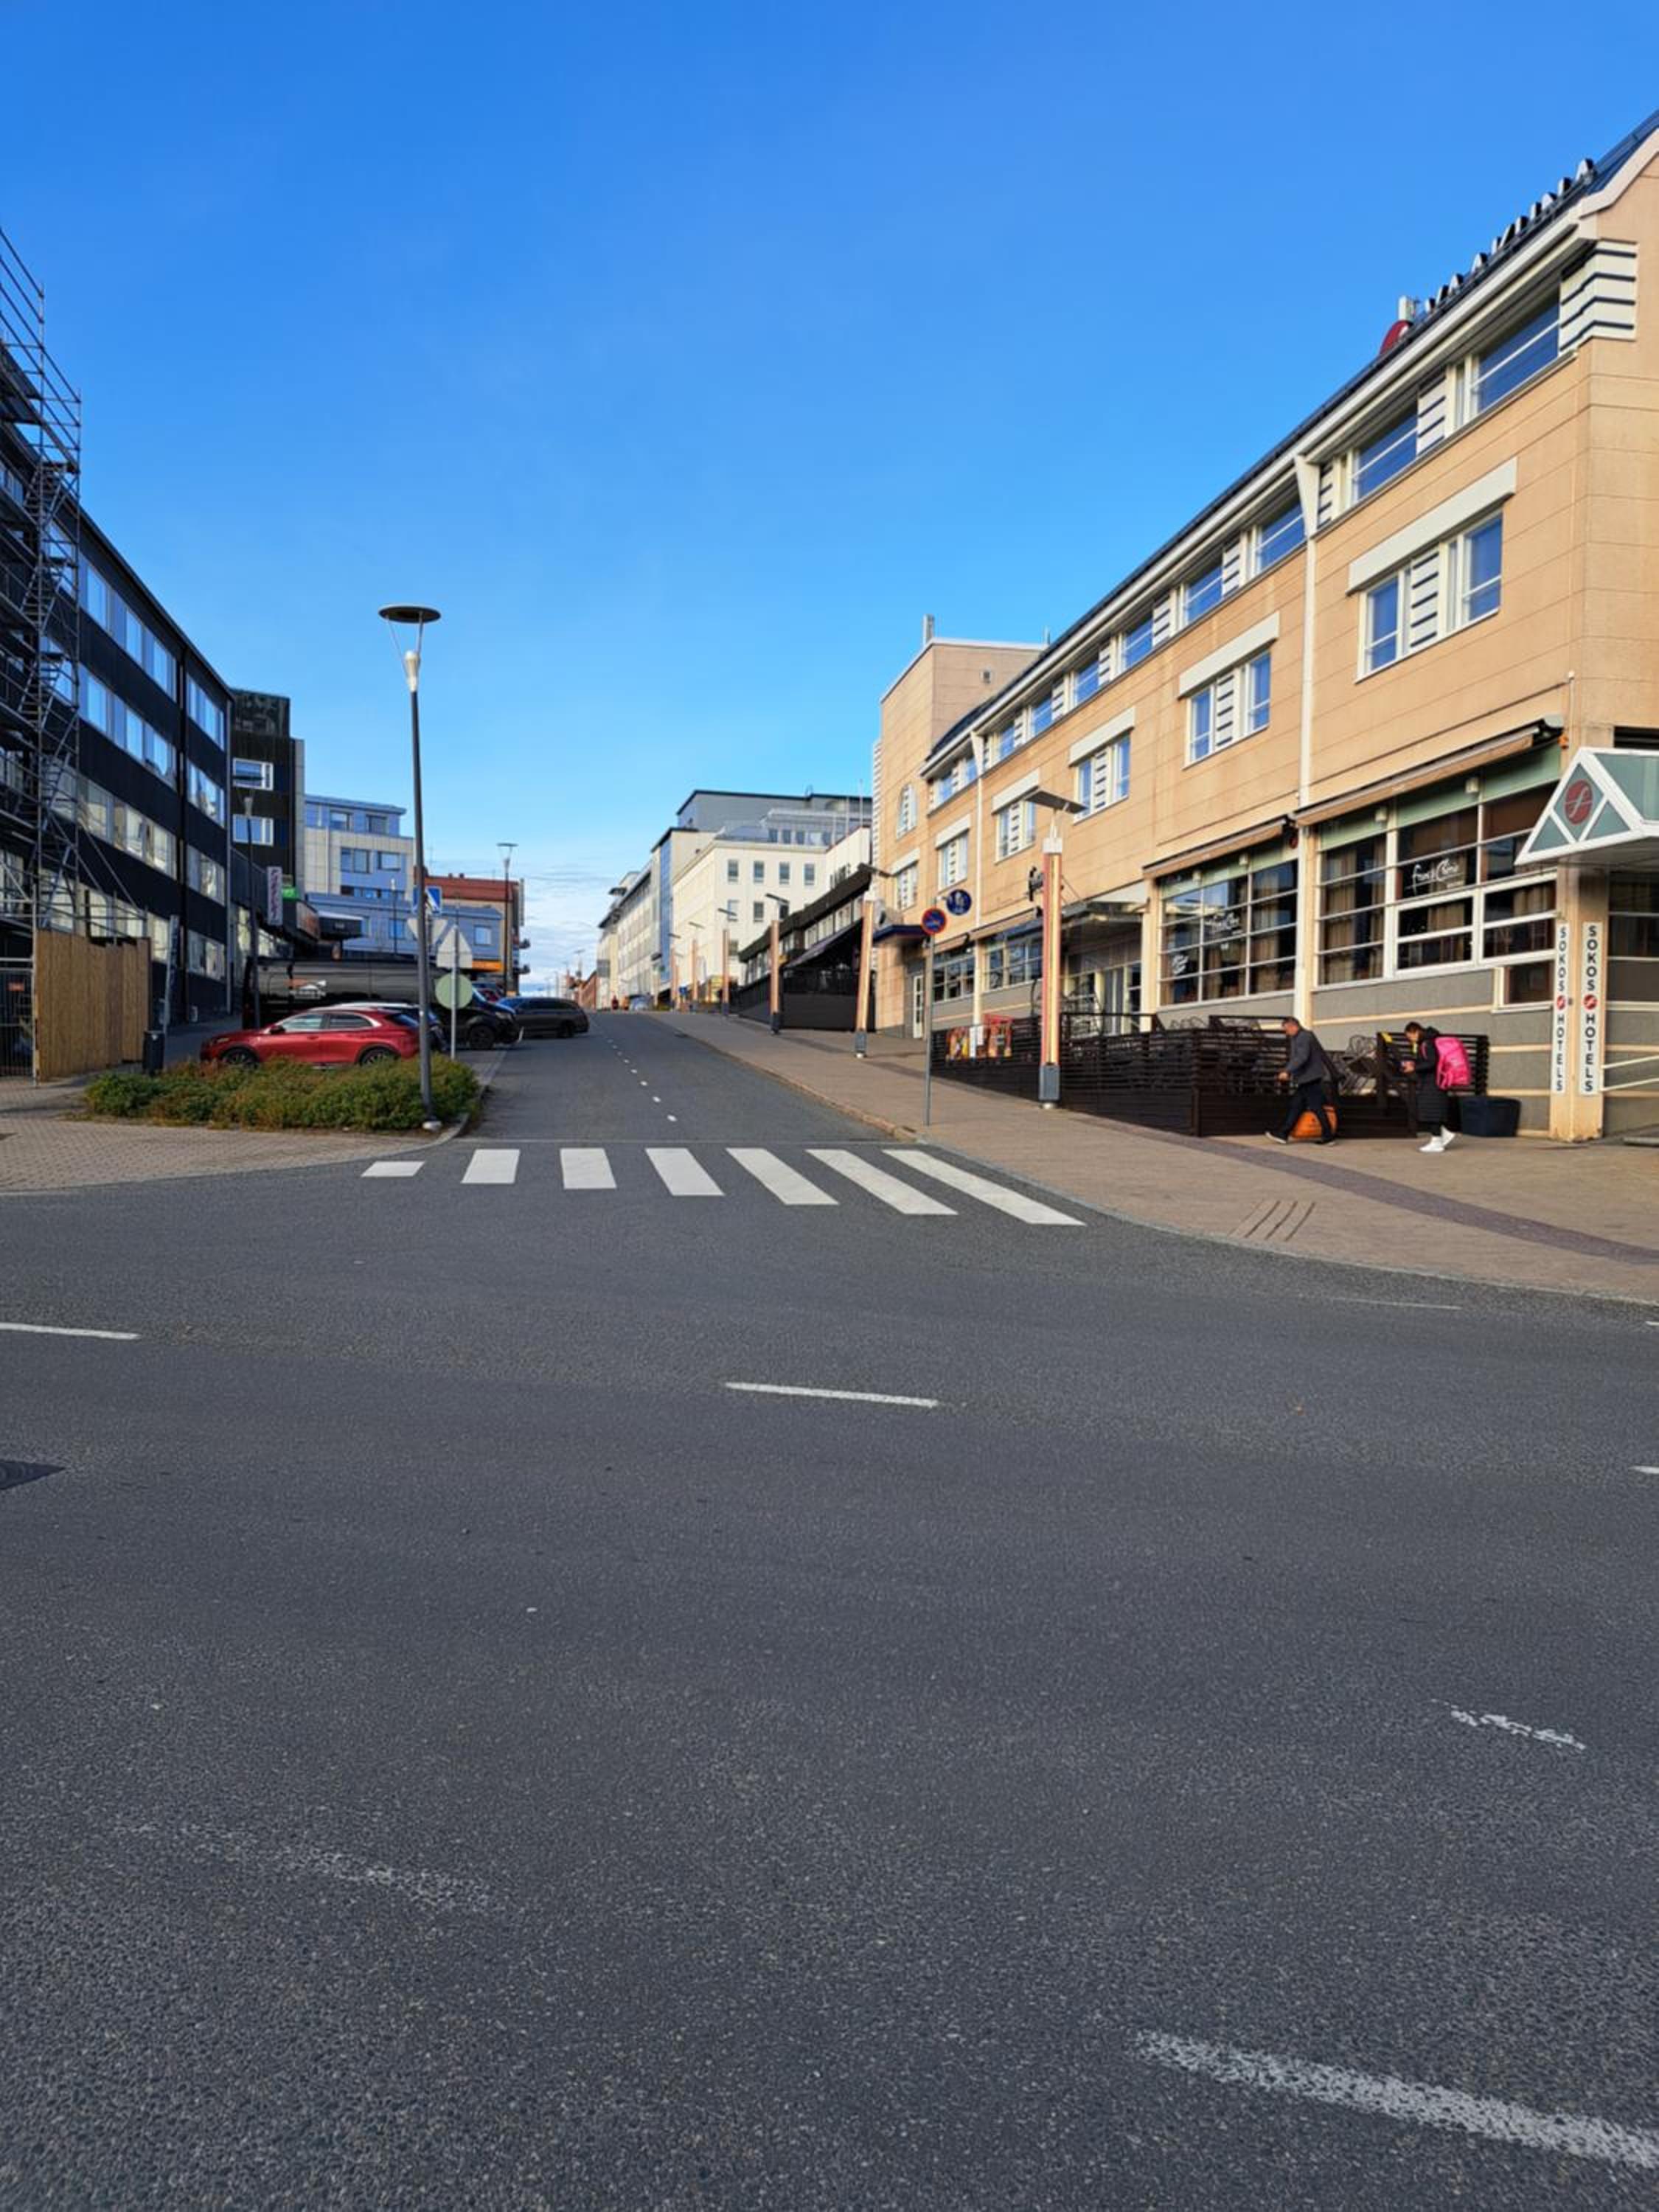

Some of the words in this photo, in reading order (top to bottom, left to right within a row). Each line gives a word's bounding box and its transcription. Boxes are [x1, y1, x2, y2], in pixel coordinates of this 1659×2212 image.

[1557, 926, 1567, 992] SOKOS
[1586, 925, 1598, 991] SOKOS
[1557, 1014, 1565, 1091] HOTELS
[1585, 1014, 1596, 1092] HOTELS
